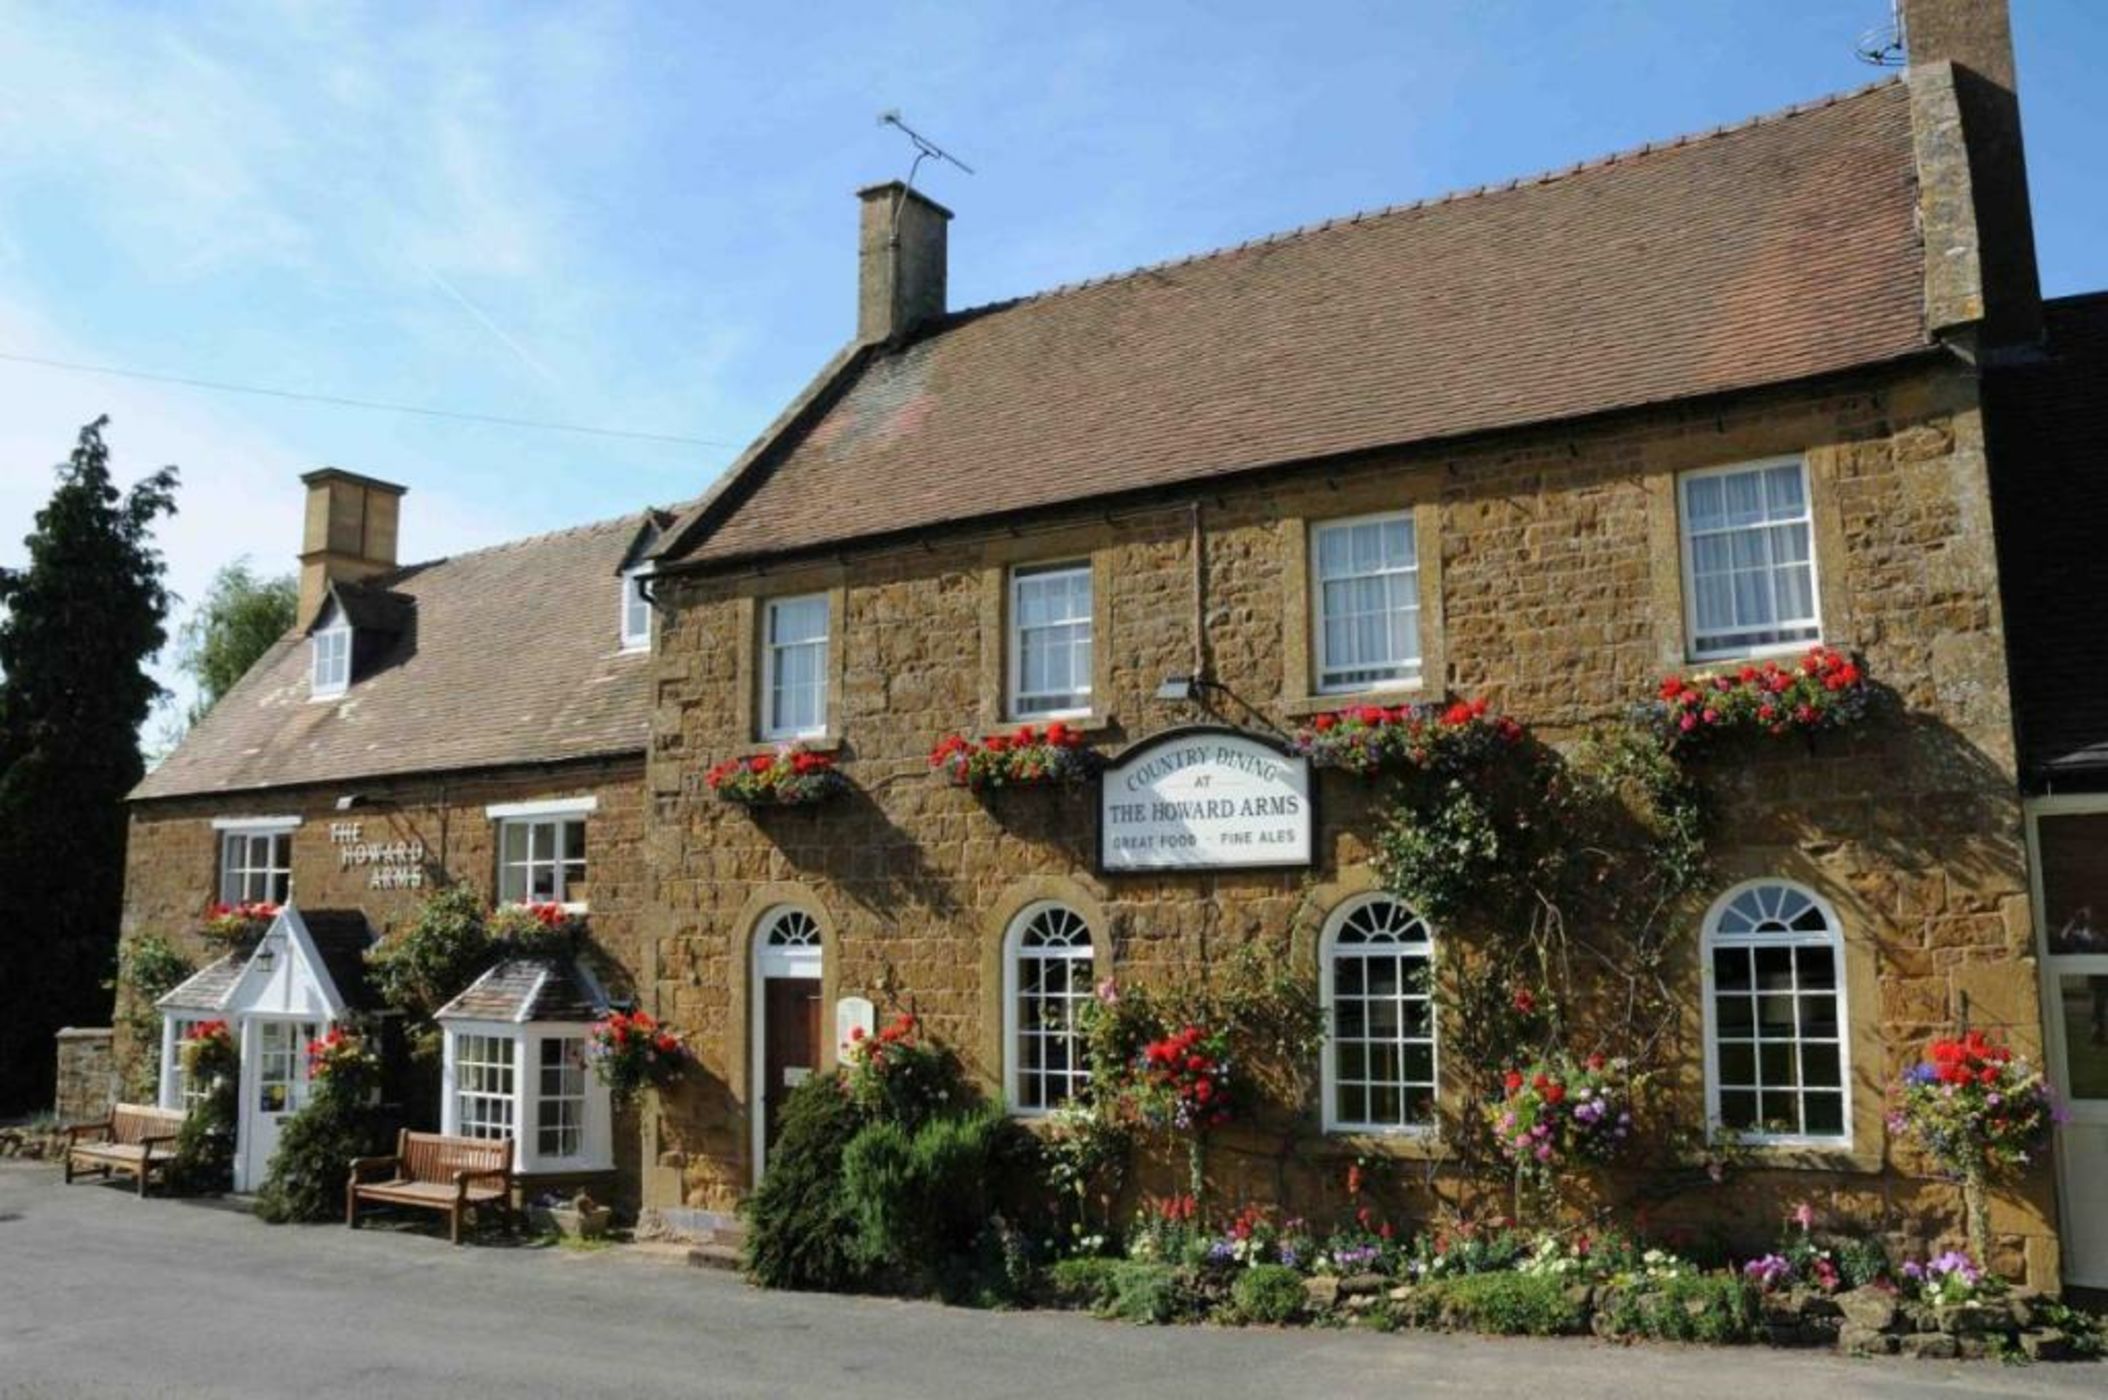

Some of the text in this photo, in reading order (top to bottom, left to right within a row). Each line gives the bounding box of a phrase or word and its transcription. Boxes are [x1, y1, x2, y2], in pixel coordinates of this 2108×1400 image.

[1127, 746, 1277, 791] COUNTRY DINING
[1194, 776, 1211, 787] AT
[1109, 796, 1299, 824] THE HOWARD ARMS
[331, 823, 363, 842] THE
[1113, 830, 1295, 849] GREAT FOOD FINE ALES
[343, 840, 423, 865] HOWARD
[371, 865, 422, 889] ARMS
